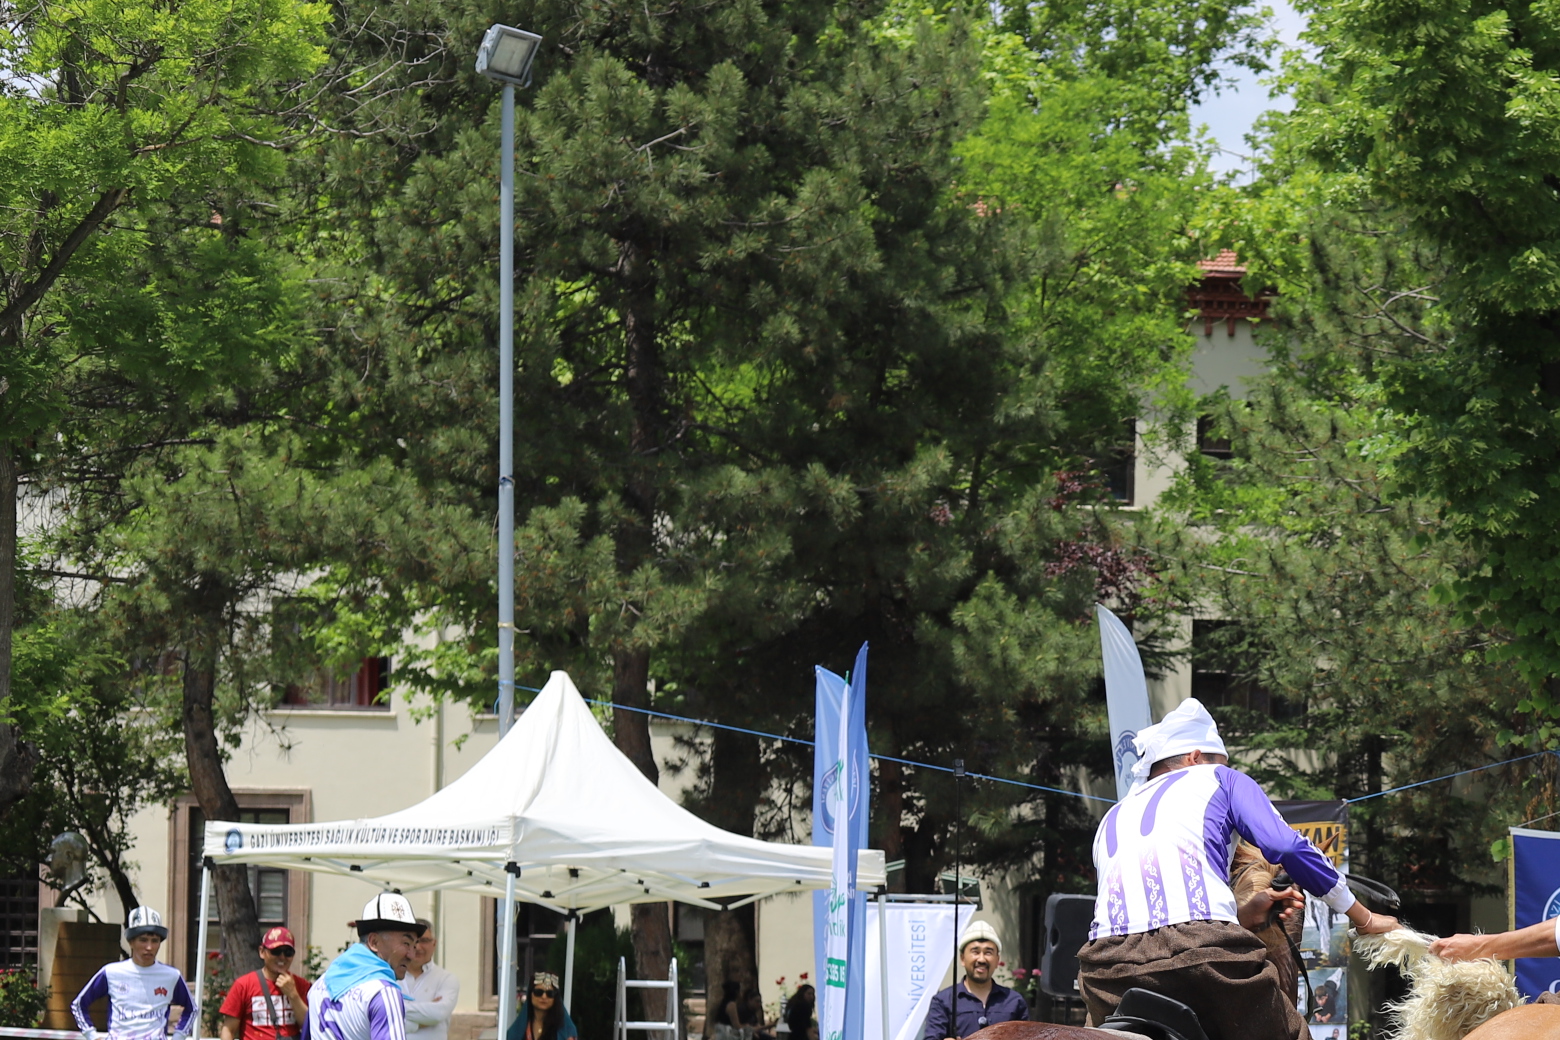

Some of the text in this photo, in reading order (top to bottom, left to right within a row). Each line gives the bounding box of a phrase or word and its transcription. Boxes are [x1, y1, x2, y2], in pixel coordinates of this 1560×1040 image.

[325, 826, 353, 845] SAĞLIK
[387, 828, 399, 844] VE
[400, 828, 421, 845] SPOR
[422, 825, 447, 845] DAİRE
[906, 919, 926, 1020] NİVERSİTESİ
